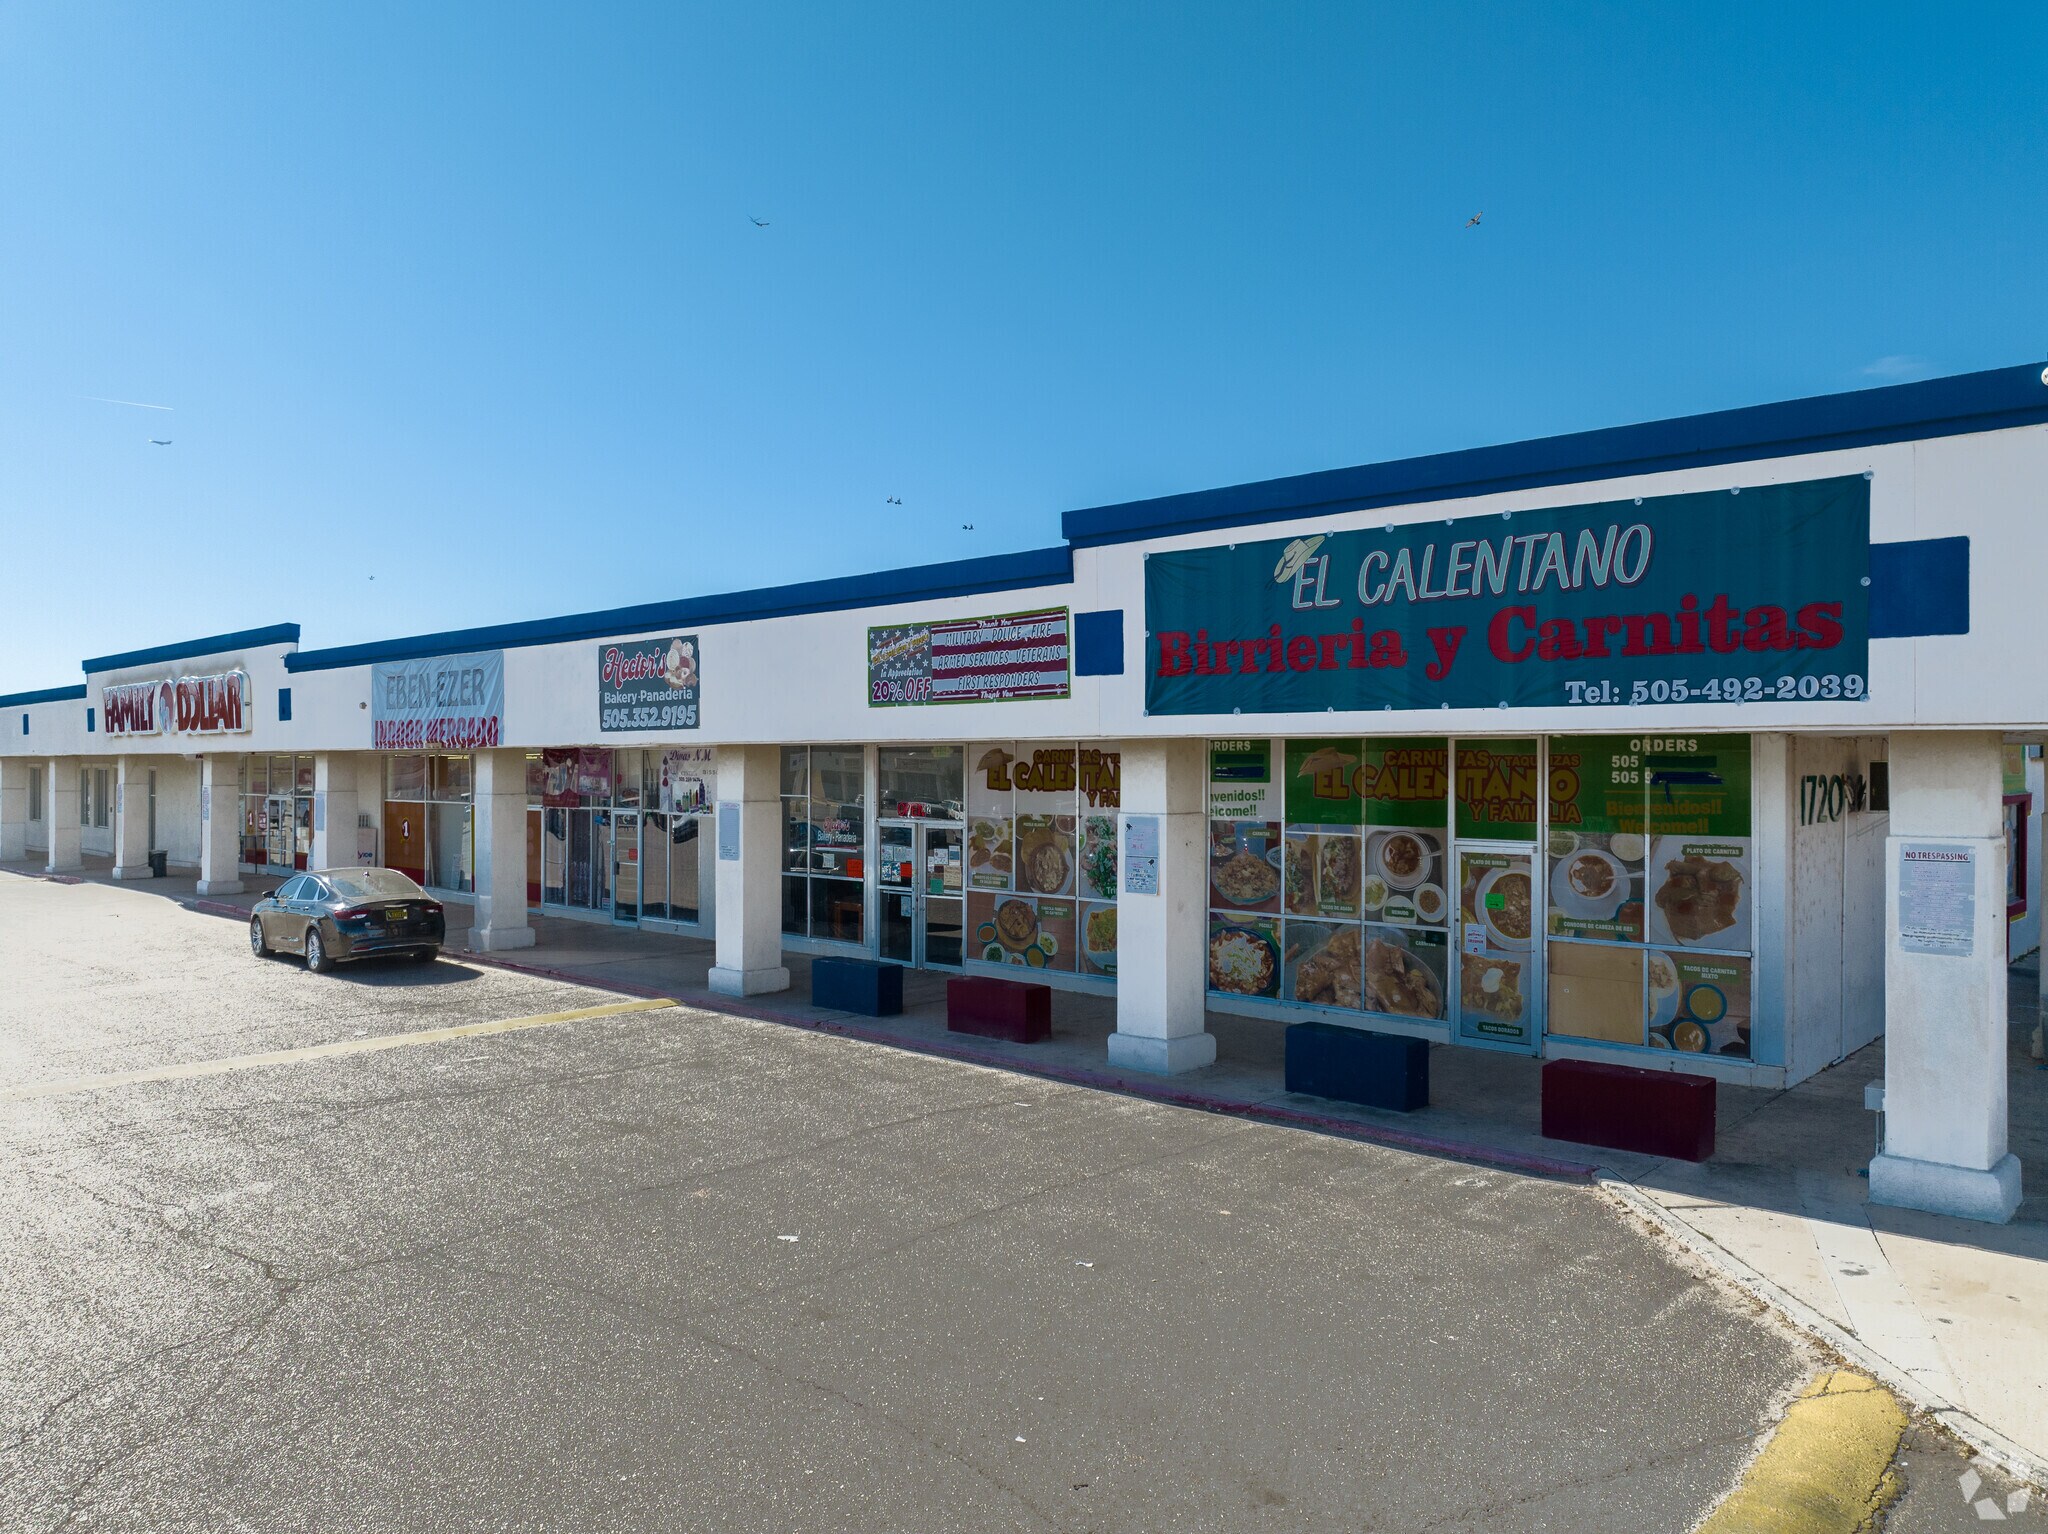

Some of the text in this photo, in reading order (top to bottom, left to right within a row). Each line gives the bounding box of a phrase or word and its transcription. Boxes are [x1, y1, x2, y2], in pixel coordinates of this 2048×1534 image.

[1291, 523, 1653, 611] EL CALENTANO
[944, 622, 1053, 647] MILITARY POLICE FIRE
[1155, 592, 1845, 682] Birrieria y Carnitas
[603, 647, 666, 689] Hector's
[937, 653, 967, 671] ARMED
[1016, 645, 1063, 663] VETERANS
[887, 667, 923, 679] Appreciation
[957, 671, 1041, 691] FIRST RESPONDERS
[872, 677, 932, 701] 20% OFF
[1565, 673, 1864, 704] Tel: 505-492-2039
[104, 675, 242, 733] FAMILY DOLLAR
[602, 704, 697, 728] 505.352.9195
[1630, 739, 1698, 752] ORDERS
[1611, 755, 1639, 768] 505
[986, 764, 1011, 791] EL
[1314, 764, 1580, 802] EL CALENTANO
[1611, 771, 1639, 784] 505
[1087, 792, 1097, 807] Y
[1469, 802, 1482, 821] Y
[1905, 851, 1969, 861] NO TRESPASSING
